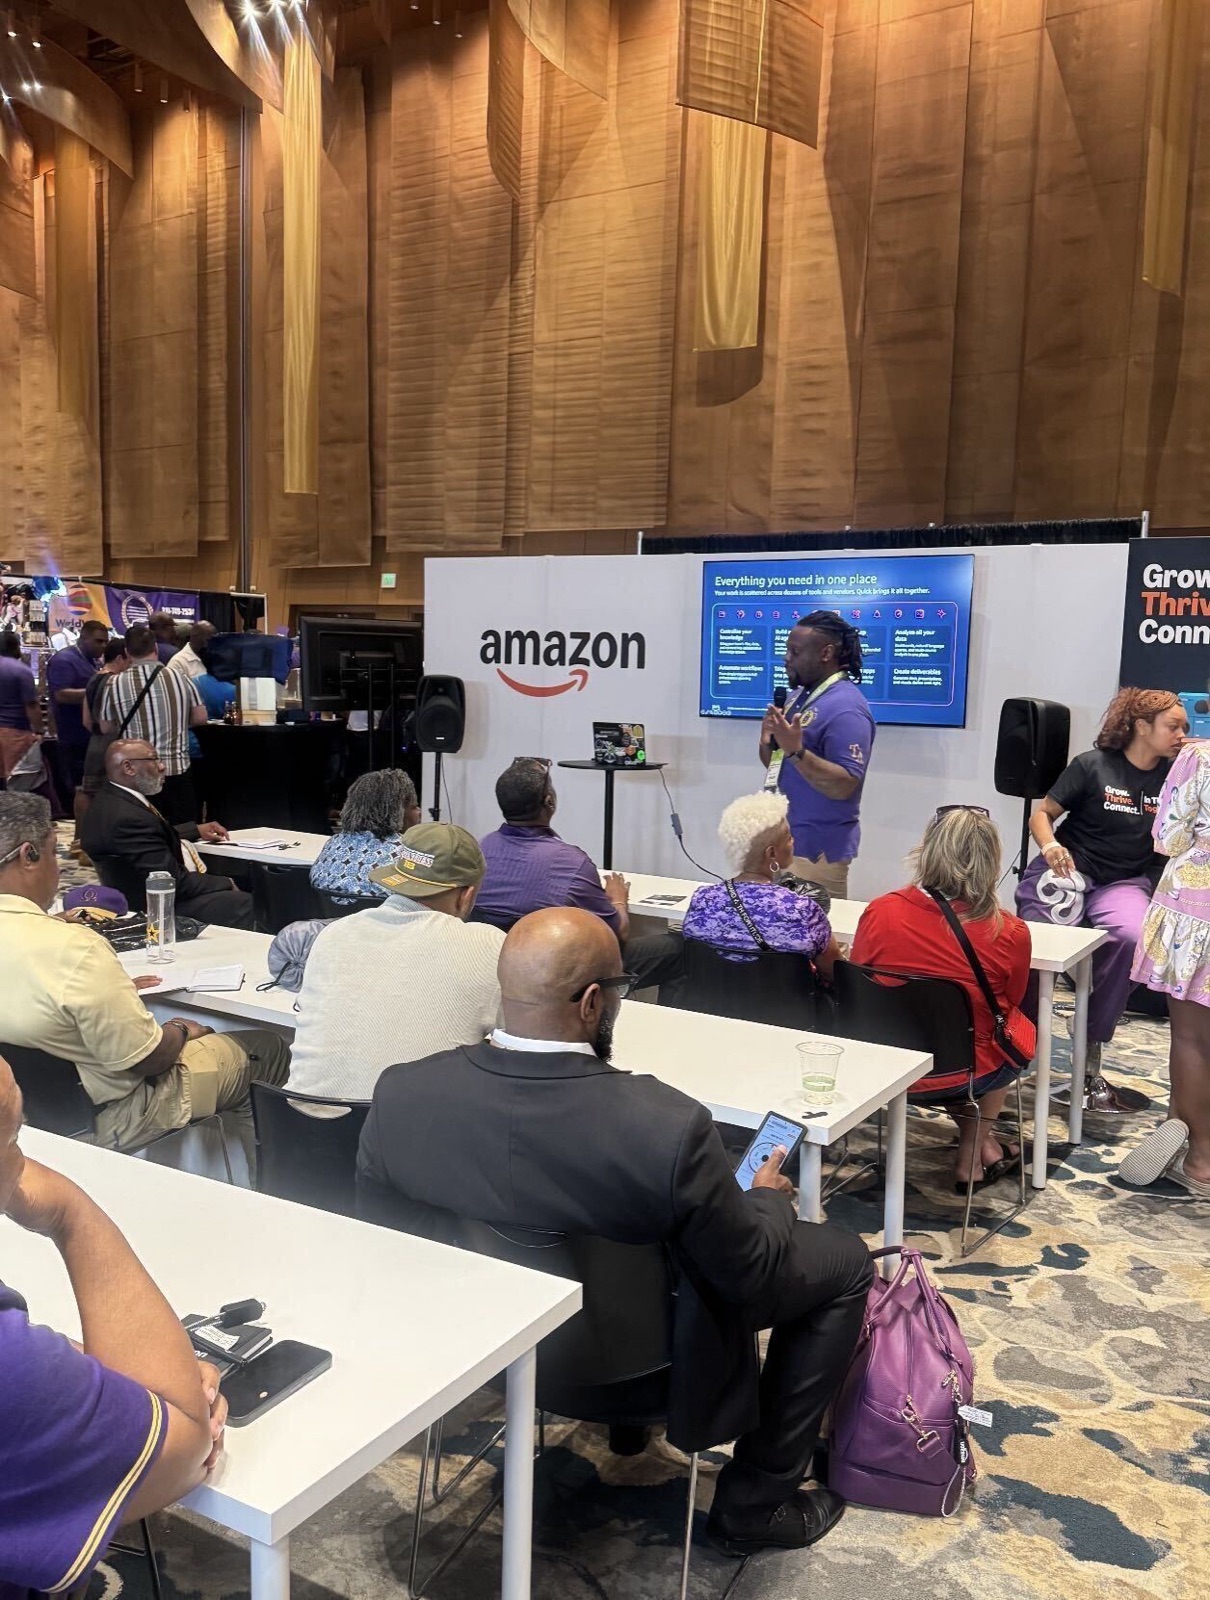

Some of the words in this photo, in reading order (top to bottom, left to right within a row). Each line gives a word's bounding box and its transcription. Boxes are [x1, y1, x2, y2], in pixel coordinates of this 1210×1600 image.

[715, 575, 765, 588] Everything
[767, 577, 786, 588] you
[788, 575, 813, 585] need
[815, 575, 825, 585] in
[827, 576, 847, 585] one
[849, 574, 878, 586] place
[856, 587, 873, 595] Quick
[873, 587, 890, 596] brings
[479, 629, 646, 669] amazon
[1104, 785, 1130, 797] Grow.
[1104, 792, 1134, 806] Thrive.
[1103, 801, 1140, 815] Connect.
